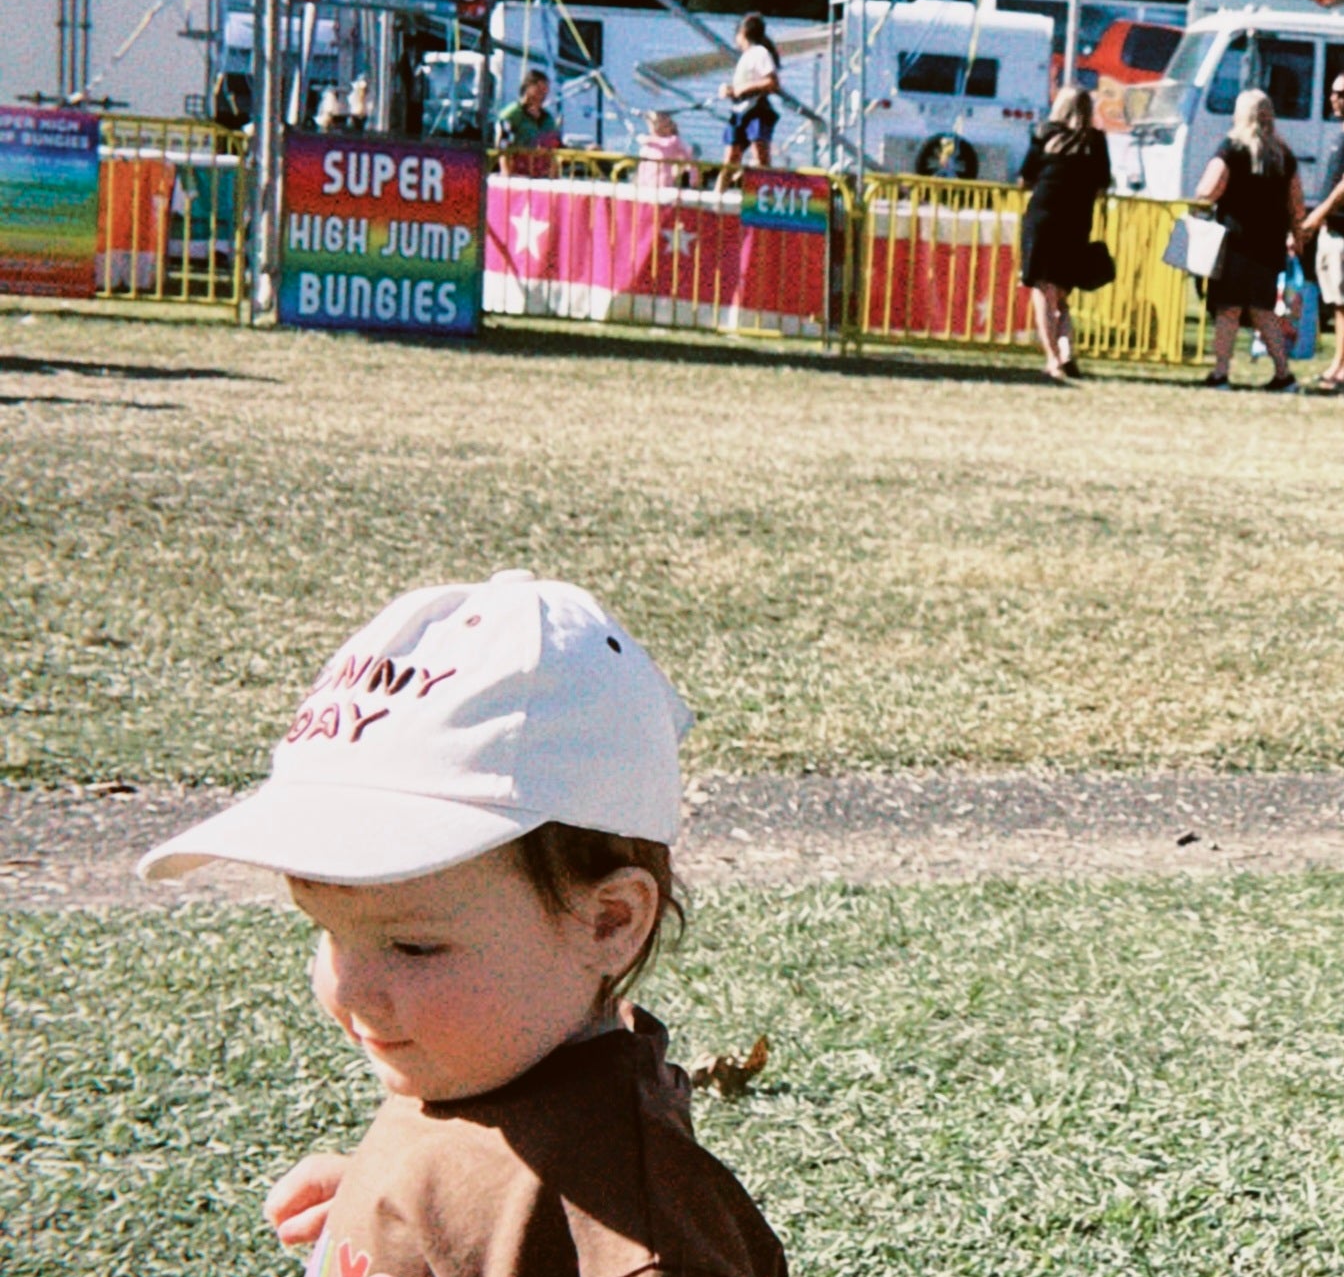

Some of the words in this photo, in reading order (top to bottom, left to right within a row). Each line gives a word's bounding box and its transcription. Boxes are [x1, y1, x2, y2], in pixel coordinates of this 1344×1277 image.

[322, 149, 445, 202] SUPER
[757, 183, 814, 216] EXIT
[289, 212, 369, 255] HIGH
[380, 220, 472, 261] JUMP
[299, 272, 458, 324] BUNGIES
